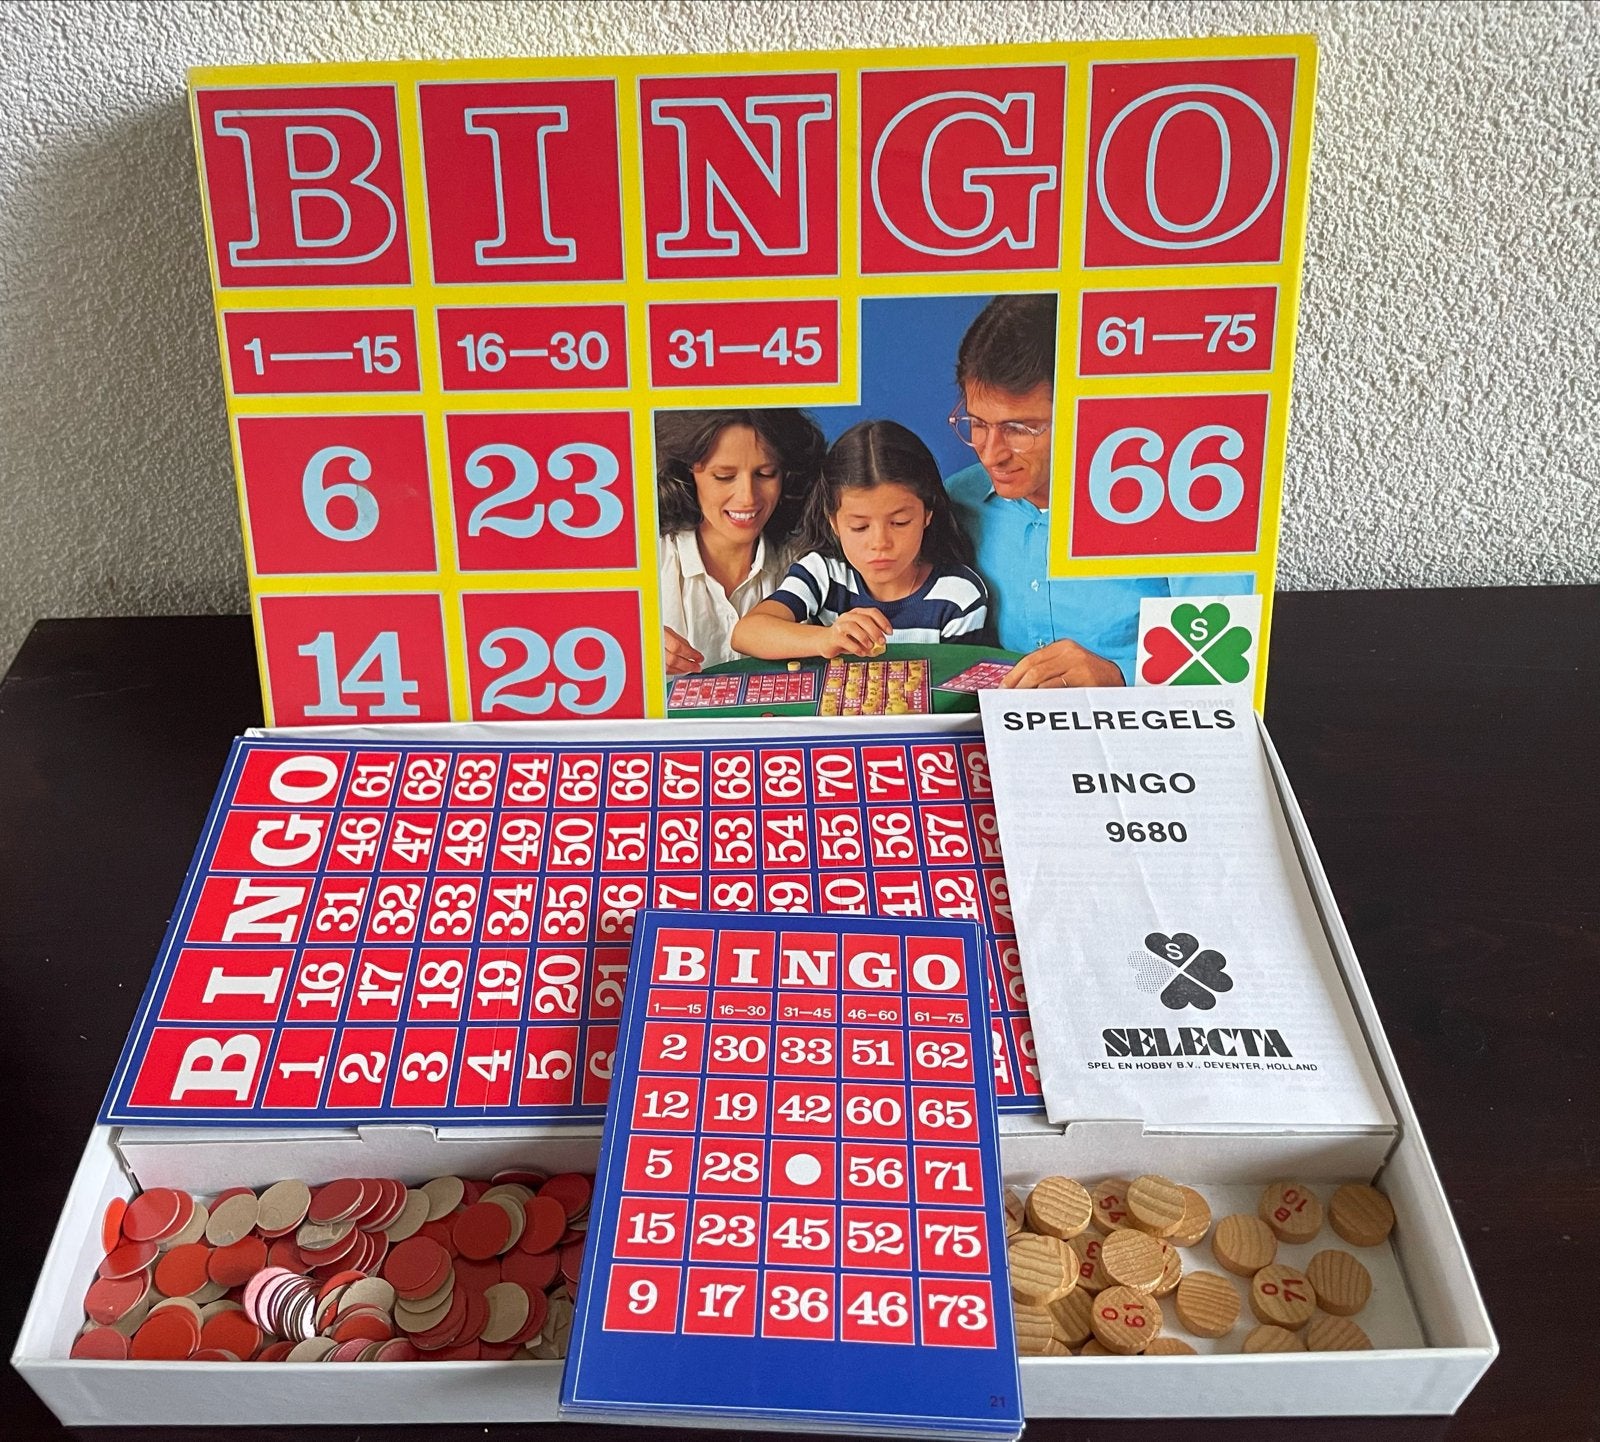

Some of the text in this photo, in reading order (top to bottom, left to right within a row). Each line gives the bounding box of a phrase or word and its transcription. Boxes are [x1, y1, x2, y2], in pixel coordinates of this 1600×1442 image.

[302, 425, 1244, 541] 6 23 66
[1190, 618, 1208, 641] S
[298, 627, 626, 716] 14 29
[1004, 710, 1235, 730] SPELREGELS
[352, 762, 394, 797] 61
[403, 759, 446, 801] 62
[454, 759, 496, 801] 63
[508, 759, 549, 802] 64
[559, 760, 598, 801] 65
[611, 759, 649, 801] 66
[663, 759, 700, 799] 67
[714, 756, 751, 799] 68
[764, 756, 802, 797] 69
[816, 755, 853, 797] 70
[867, 756, 905, 793] 71
[918, 752, 956, 793] 72
[1073, 773, 1195, 793] BINGO
[337, 818, 381, 864] 46
[392, 820, 433, 863] 47
[445, 819, 487, 866] 48
[500, 819, 541, 864] 49
[552, 818, 593, 866] 50
[606, 823, 645, 861] 51
[660, 818, 698, 863] 52
[714, 817, 752, 863] 53
[767, 815, 806, 862] 54
[819, 815, 860, 860] 55
[872, 813, 913, 858] 56
[925, 813, 968, 857] 57
[1106, 822, 1187, 842] 9680
[316, 888, 365, 931] 31
[373, 884, 421, 934] 32
[430, 884, 476, 935] 33
[487, 884, 533, 935] 34
[544, 885, 587, 935] 35
[601, 884, 644, 934] 36
[659, 884, 697, 909] 7
[713, 881, 753, 912] 8
[768, 881, 809, 913] 9
[825, 878, 866, 914] 0
[659, 945, 961, 991] BINGO
[1165, 942, 1184, 961] S
[297, 955, 628, 1013] 16 17 18 19 20 21
[660, 1034, 968, 1068] 2 30 33 51 62
[1103, 1028, 1292, 1057] SELECTA
[279, 1056, 325, 1078] 1
[339, 1052, 386, 1083] 2
[402, 1052, 448, 1082] 3
[467, 1050, 511, 1081] 4
[526, 1050, 571, 1079] 5
[1087, 1062, 1115, 1070] SPEL
[1136, 1062, 1172, 1070] HOBBY
[1204, 1062, 1264, 1071] DEVENTER,
[642, 1091, 972, 1128] 12 19 42 60 65
[645, 1149, 973, 1191] 5 28 56 71
[627, 1213, 981, 1257] 15 23 45 52 75
[629, 1280, 987, 1330] 9 17 36 46 73
